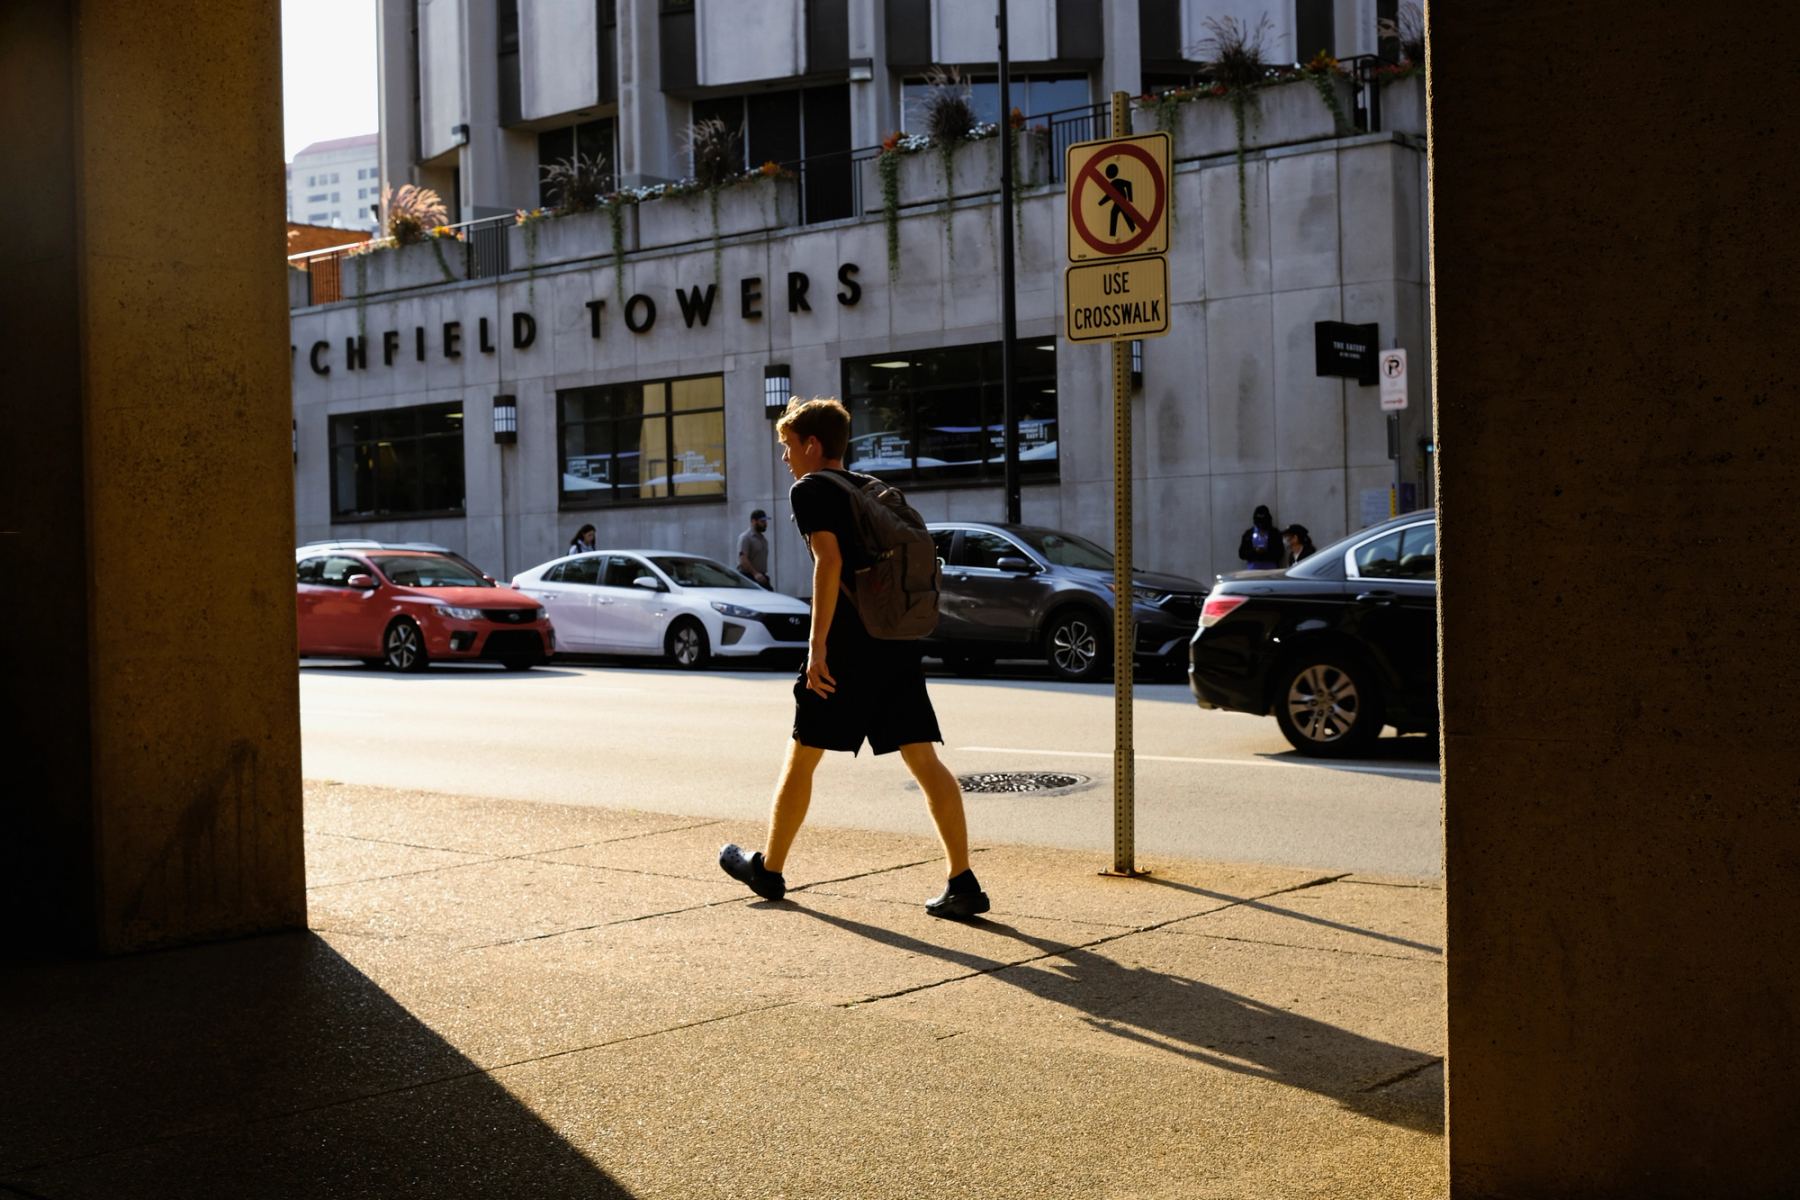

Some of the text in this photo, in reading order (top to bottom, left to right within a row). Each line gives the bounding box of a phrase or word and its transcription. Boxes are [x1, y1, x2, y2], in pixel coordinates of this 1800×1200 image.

[1103, 271, 1130, 296] USE
[291, 262, 862, 376] CHFIELD TOWERS
[1074, 299, 1161, 331] CROSSWALK
